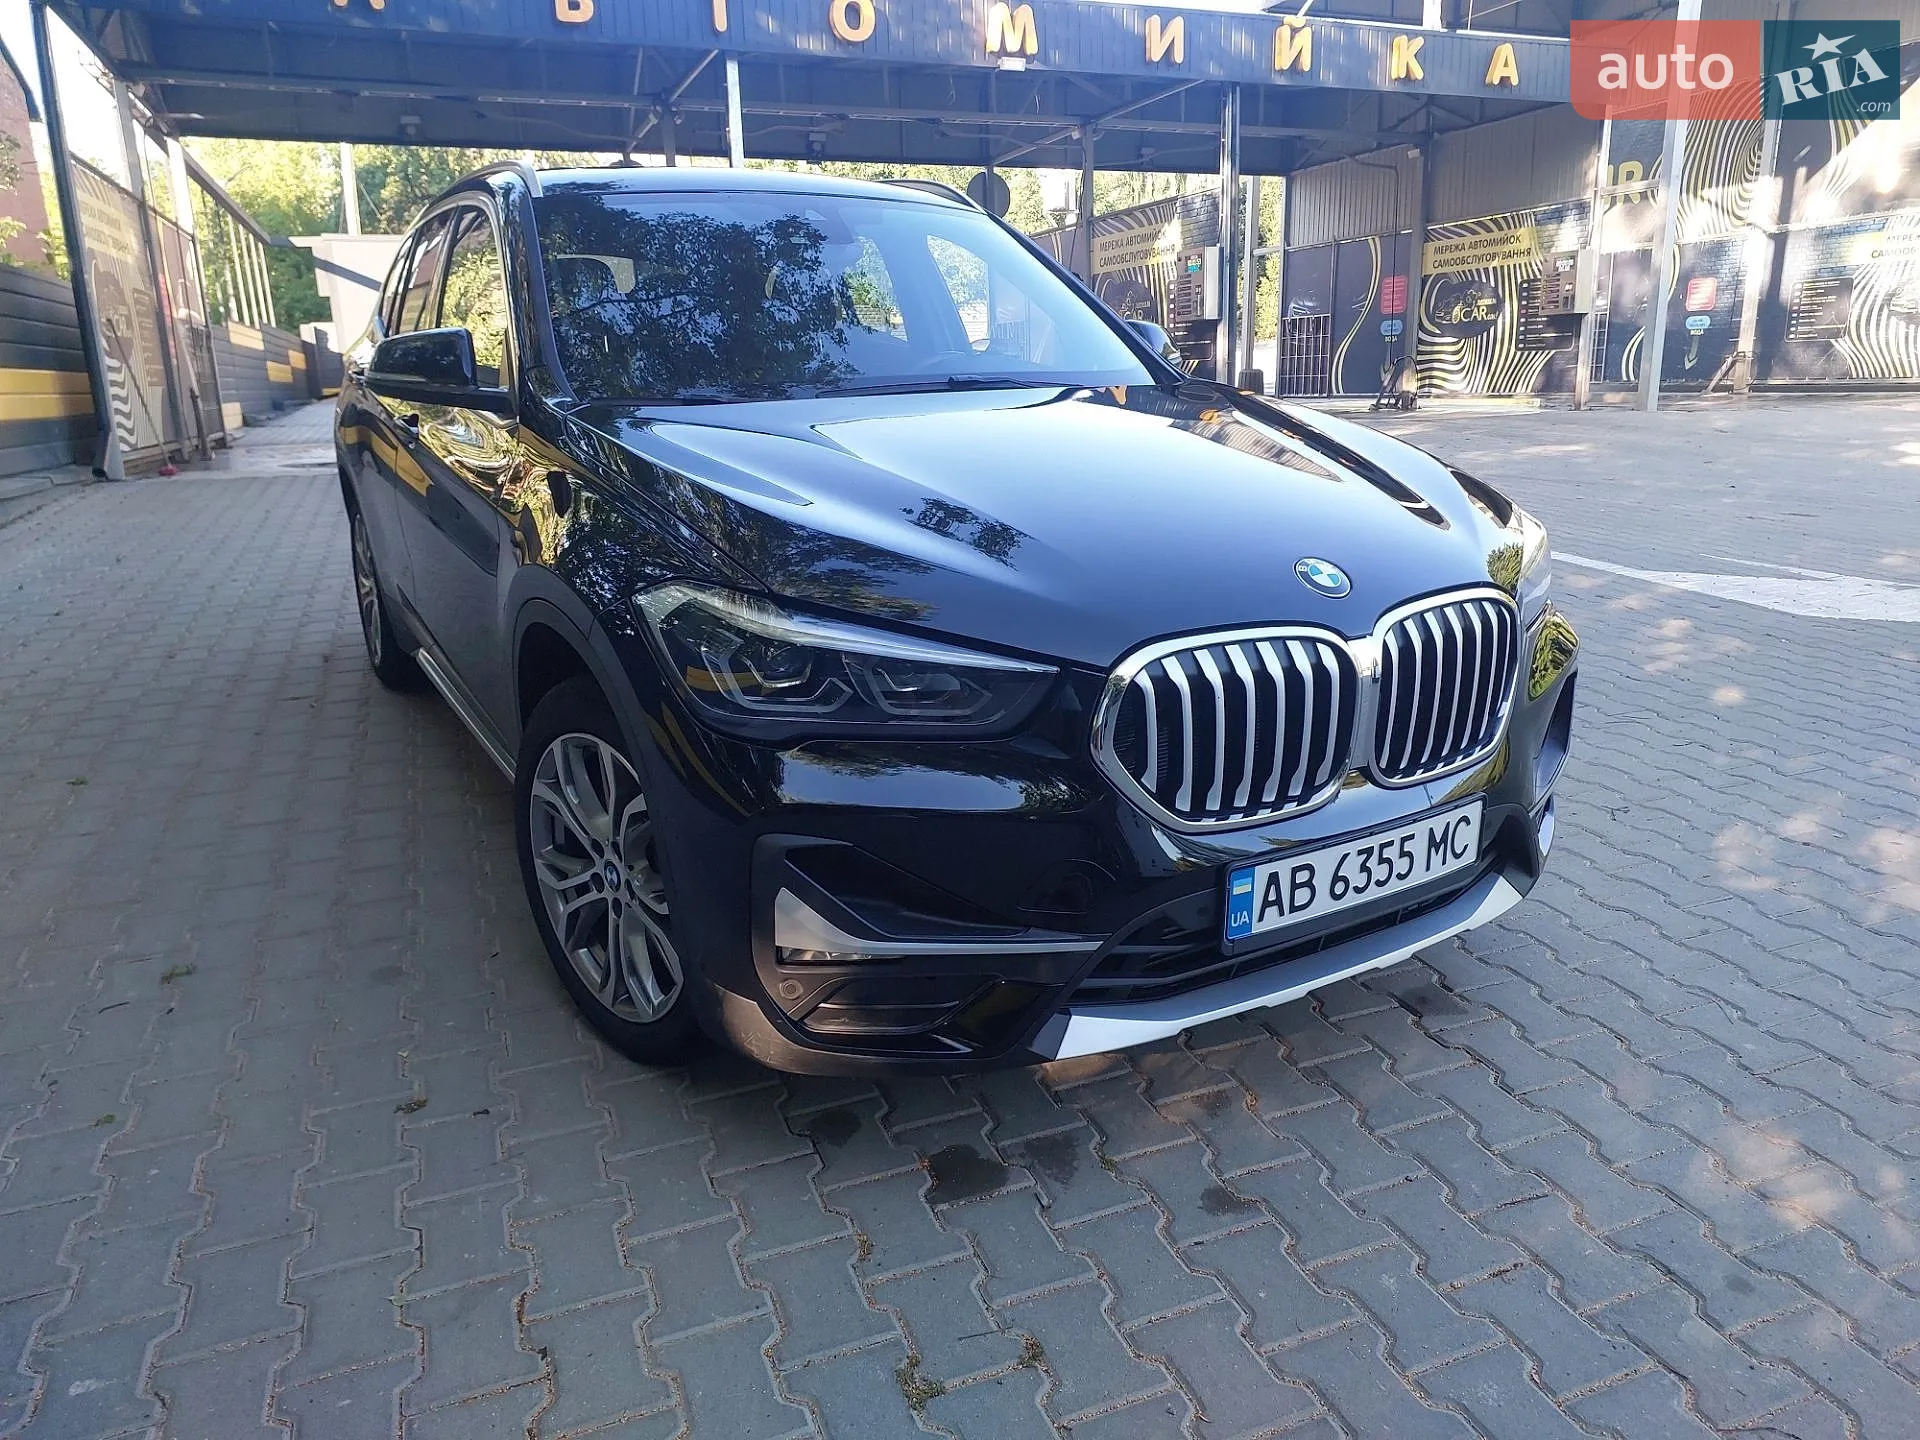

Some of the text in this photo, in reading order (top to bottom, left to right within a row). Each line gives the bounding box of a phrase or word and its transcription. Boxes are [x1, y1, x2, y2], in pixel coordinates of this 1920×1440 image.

[333, 0, 1519, 87] ОМИЙКА
[1099, 239, 1124, 253] МЕРЕЖА
[1433, 233, 1521, 256] МЕРЕЖА АВТОМИЙОК
[1871, 247, 1919, 259] САМООБ
[1099, 244, 1175, 268] САМООБСЛУГОВУВАННЯ
[1432, 247, 1531, 269] САМООБСЛУГОВУВАННЯ
[1257, 815, 1471, 922] AB 6355 MC
[1231, 910, 1250, 928] UA
